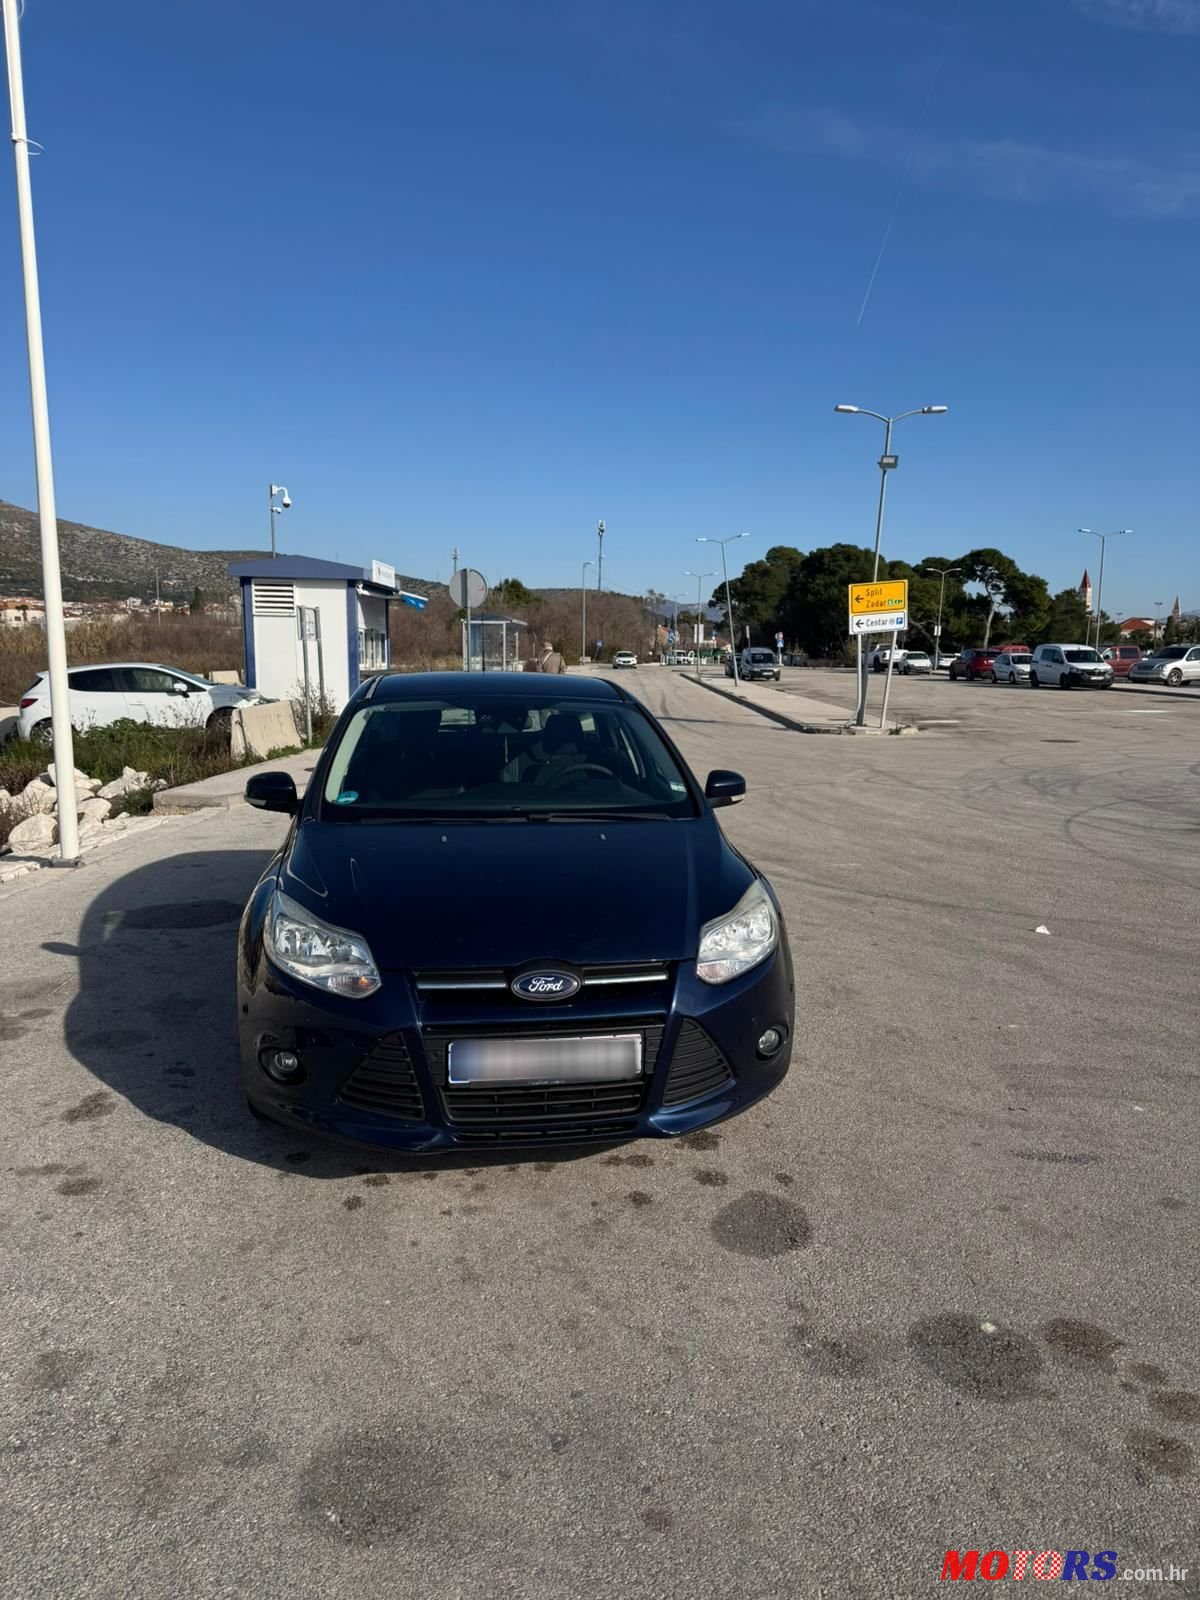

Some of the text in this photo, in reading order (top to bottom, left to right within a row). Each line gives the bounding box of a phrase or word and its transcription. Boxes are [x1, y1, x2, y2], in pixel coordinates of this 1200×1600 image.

[866, 588, 882, 597] Split
[866, 599, 886, 608] Zadar
[866, 618, 888, 627] Centar
[528, 976, 564, 992] Ford
